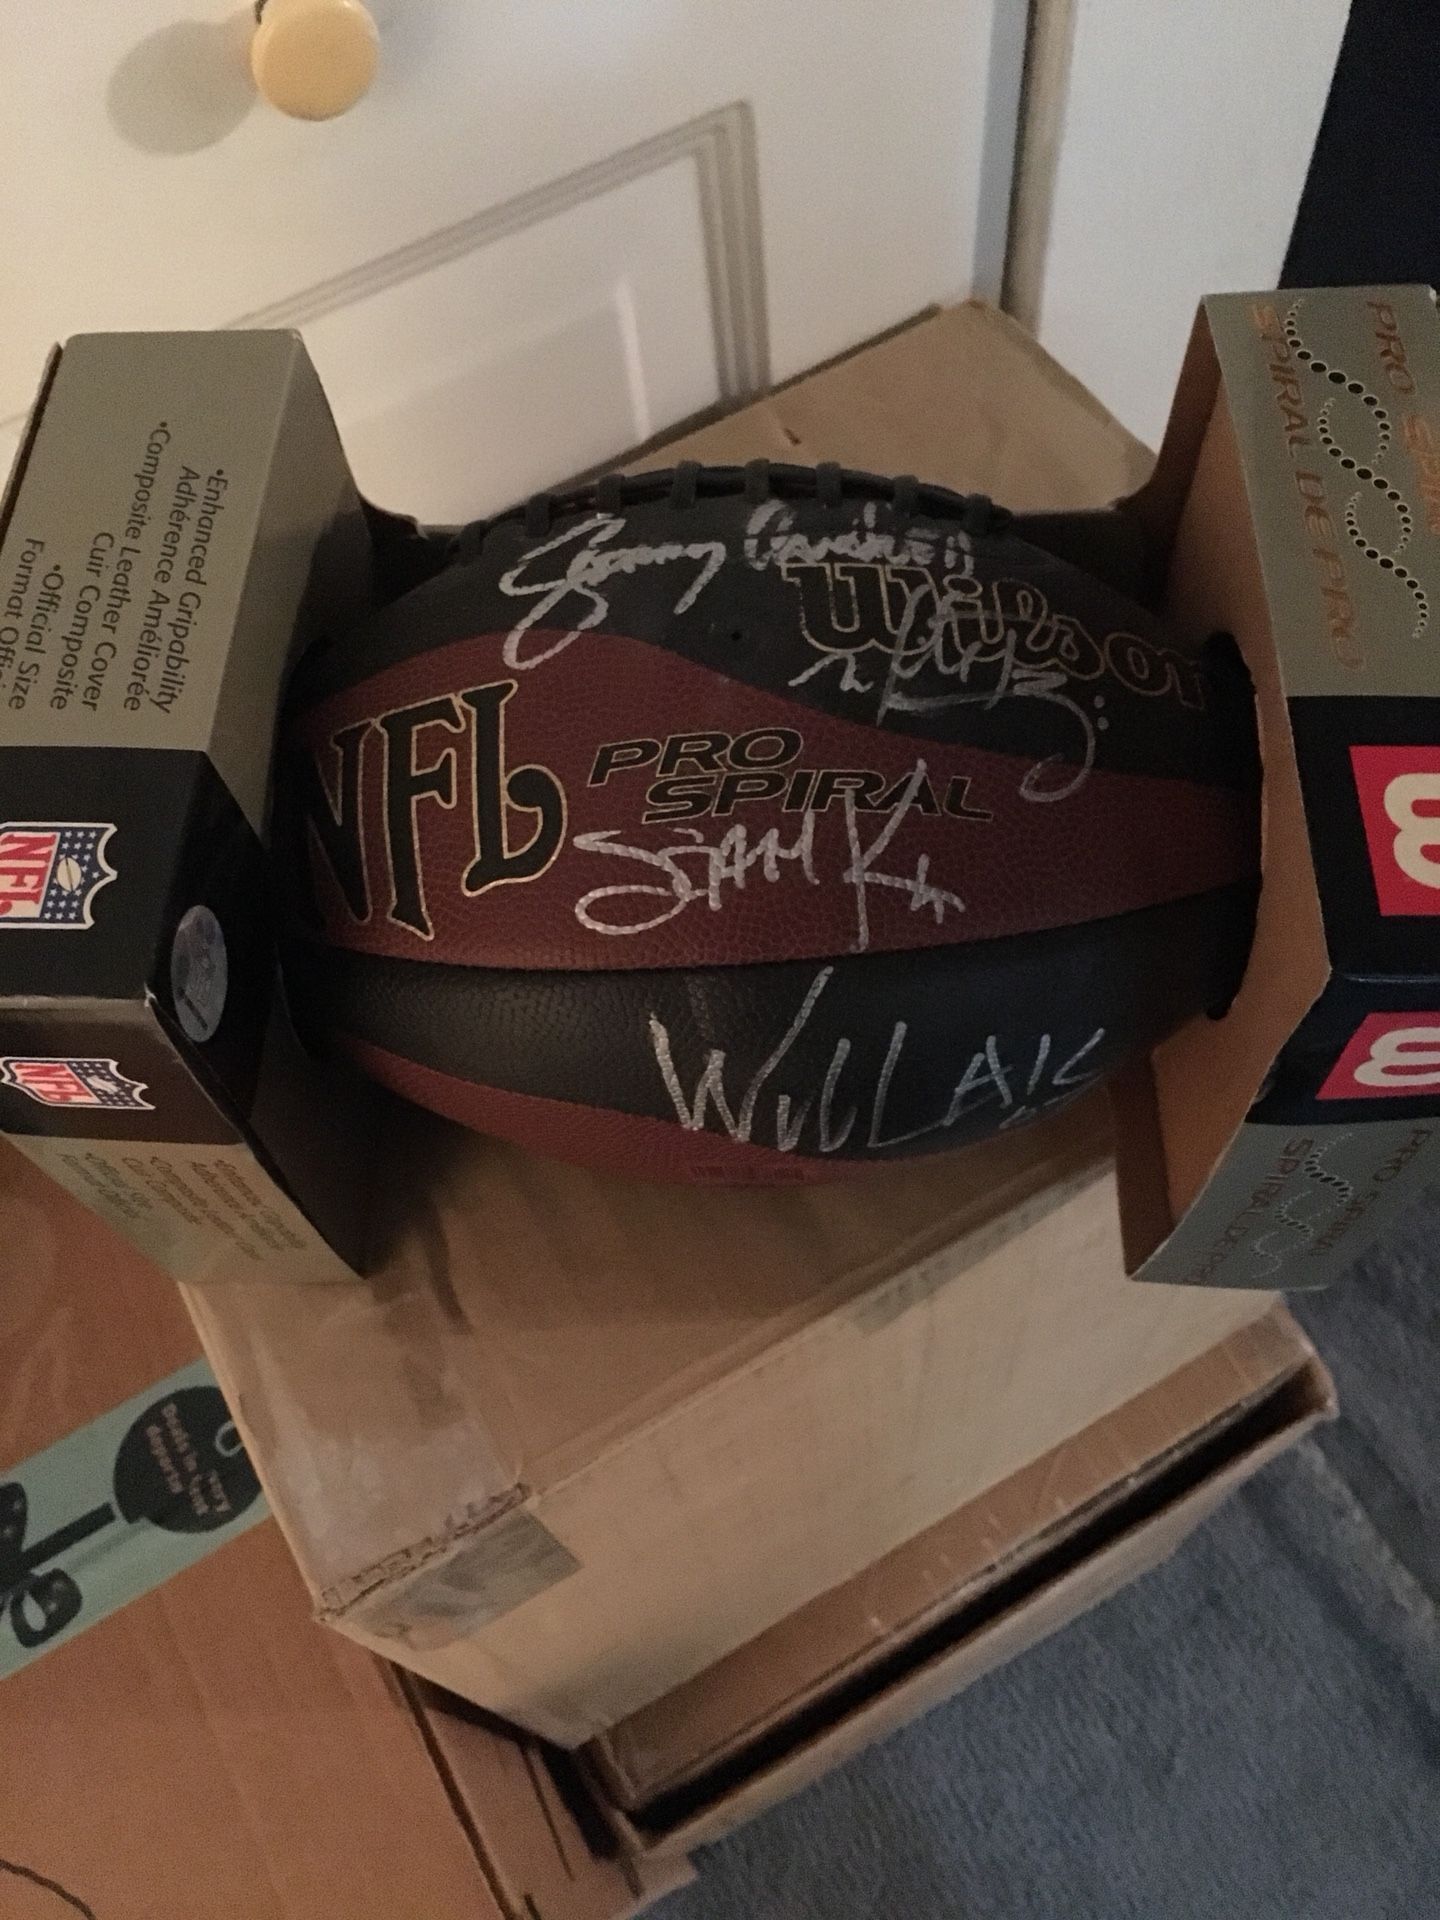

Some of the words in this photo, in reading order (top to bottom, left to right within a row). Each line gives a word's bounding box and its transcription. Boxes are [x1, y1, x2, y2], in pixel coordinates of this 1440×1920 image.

[124, 427, 172, 541] Composite
[153, 465, 201, 585] Adhérence
[86, 532, 116, 579] Cuir
[185, 472, 229, 587] Enhanced
[4, 538, 45, 619] Format
[24, 572, 64, 654] Official
[101, 546, 141, 635] Leather
[8, 660, 40, 711] Size
[50, 584, 101, 711] Composite
[82, 640, 118, 713] Cover
[123, 589, 171, 713] Améliorée
[150, 590, 202, 715] Gripability
[587, 729, 803, 788] PRO
[642, 769, 994, 825] SPIRAL
[303, 679, 568, 941] NFL
[0, 834, 57, 916] NFL
[13, 1062, 95, 1103] NFL
